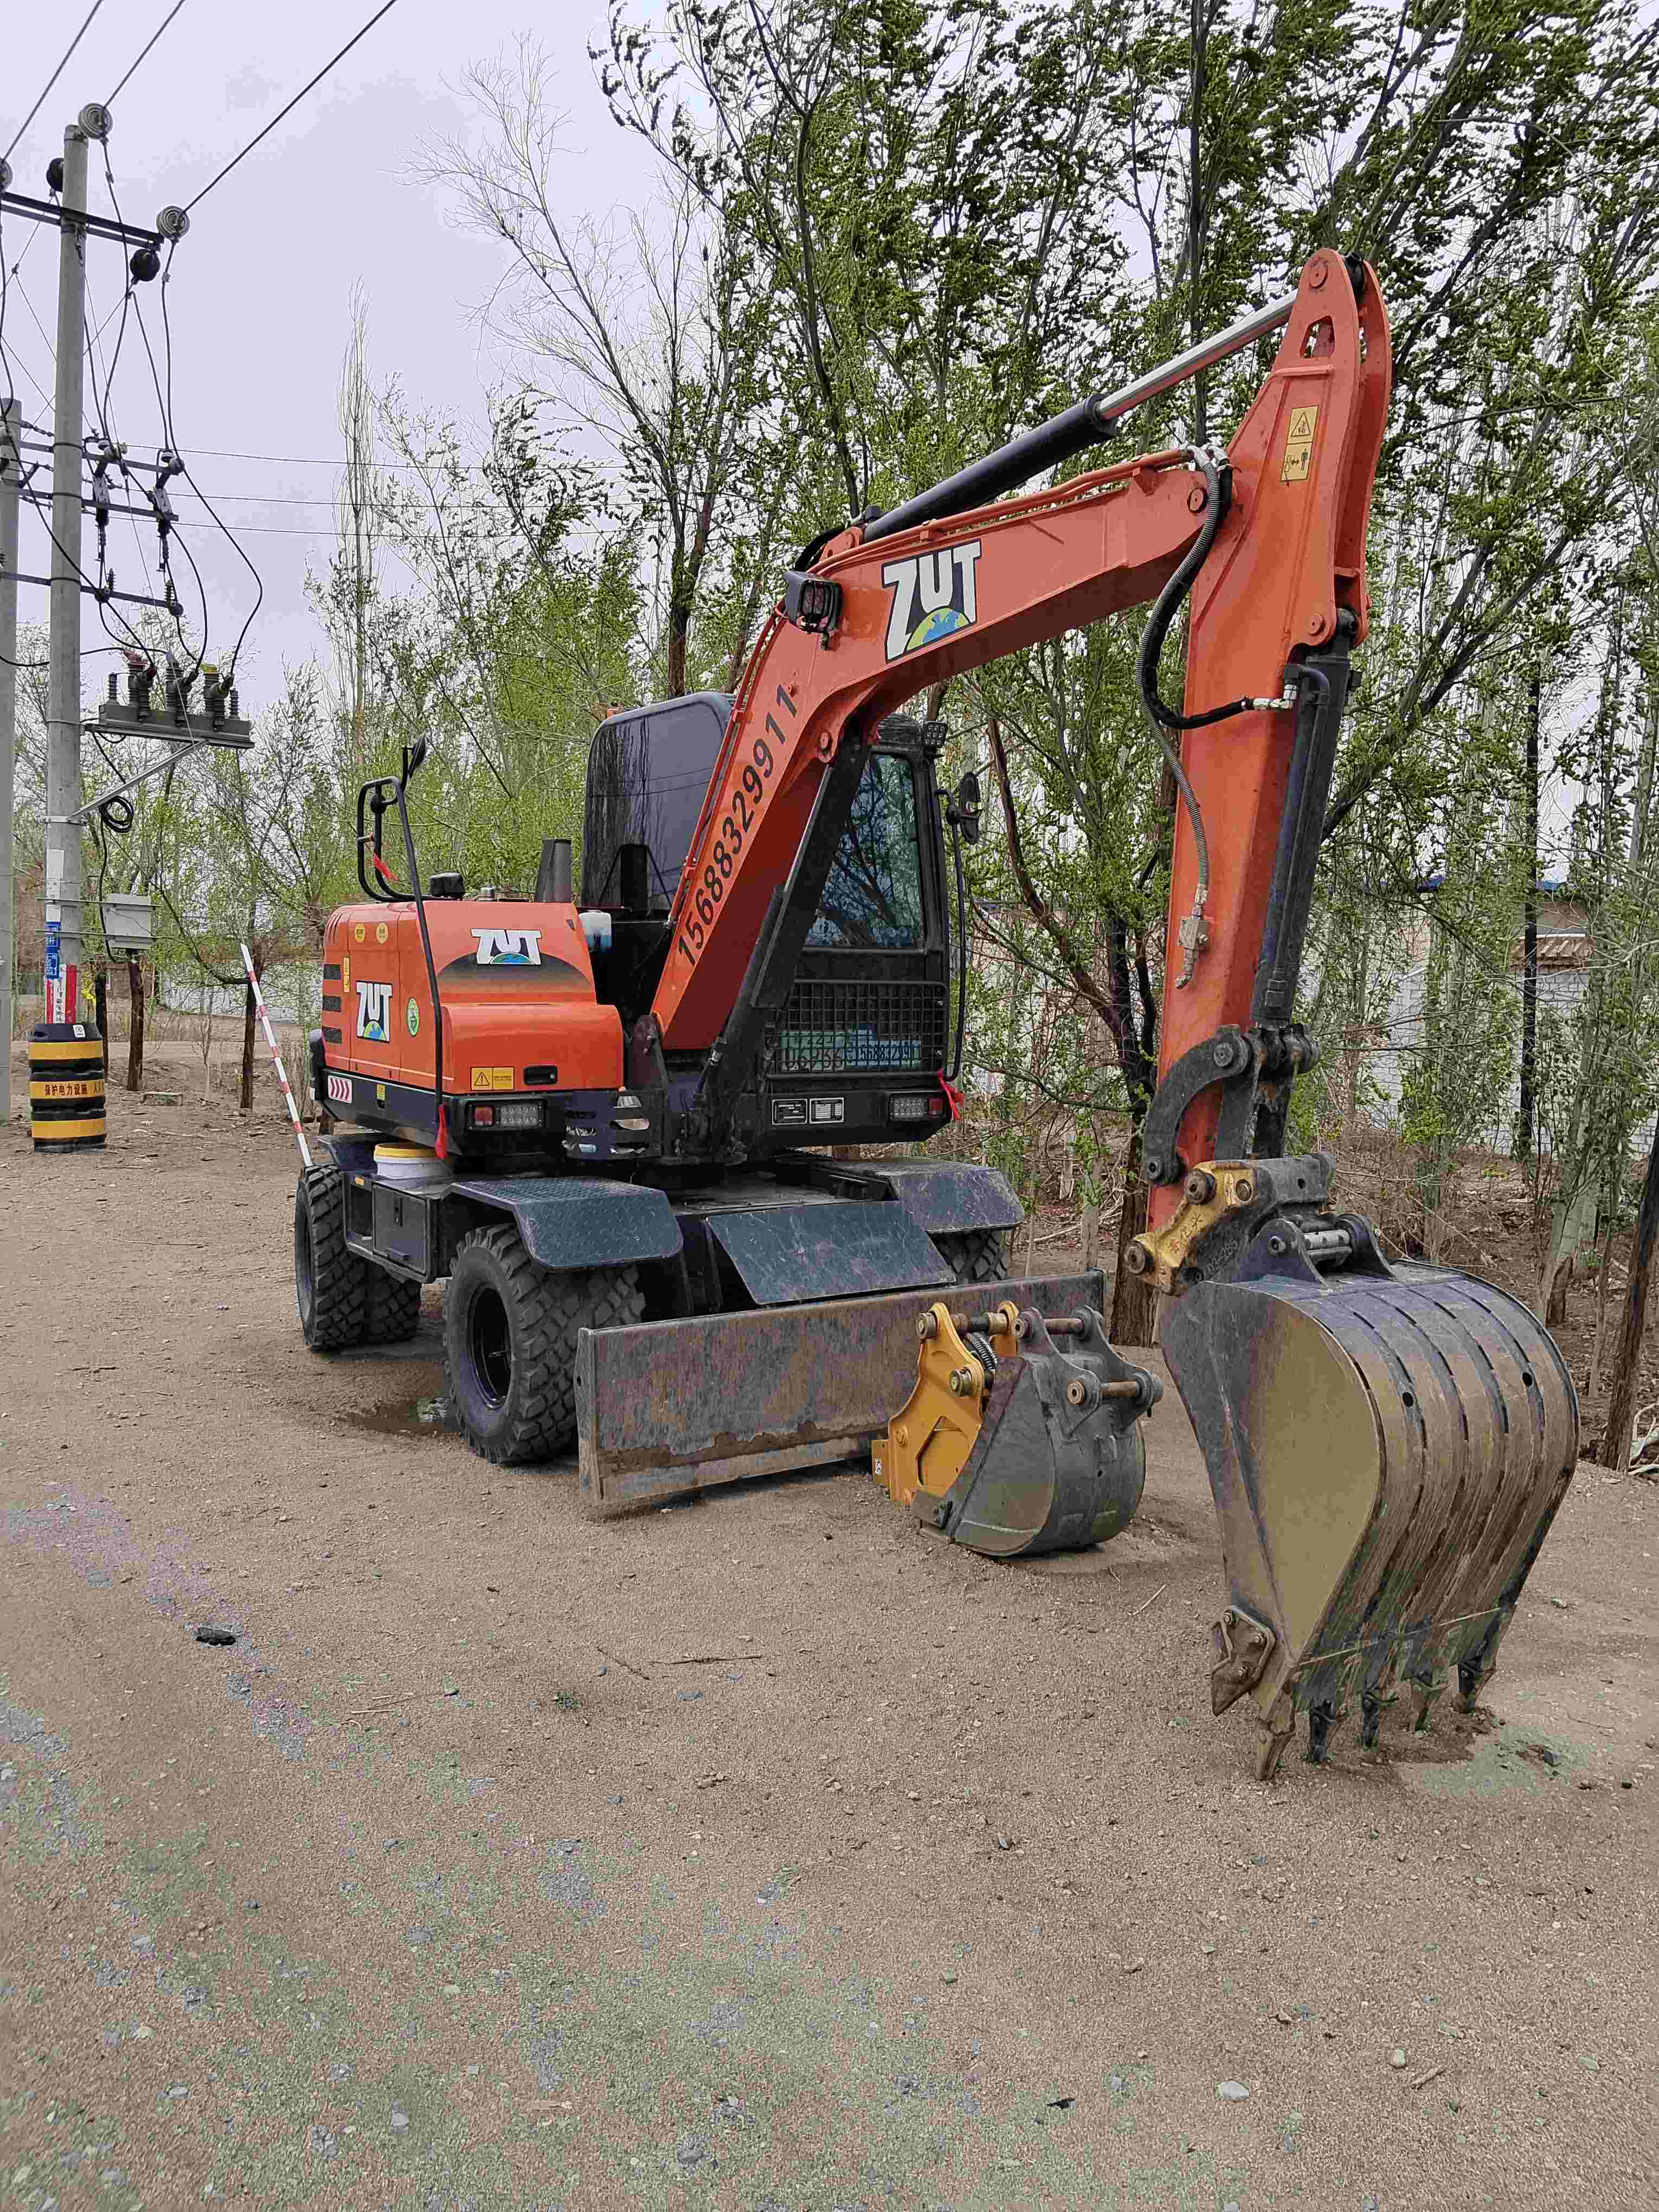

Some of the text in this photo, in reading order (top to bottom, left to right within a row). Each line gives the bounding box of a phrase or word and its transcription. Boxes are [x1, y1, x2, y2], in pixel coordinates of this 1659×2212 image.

[678, 684, 799, 967] 15688329911
[44, 1083, 88, 1096] 保护电力设施
